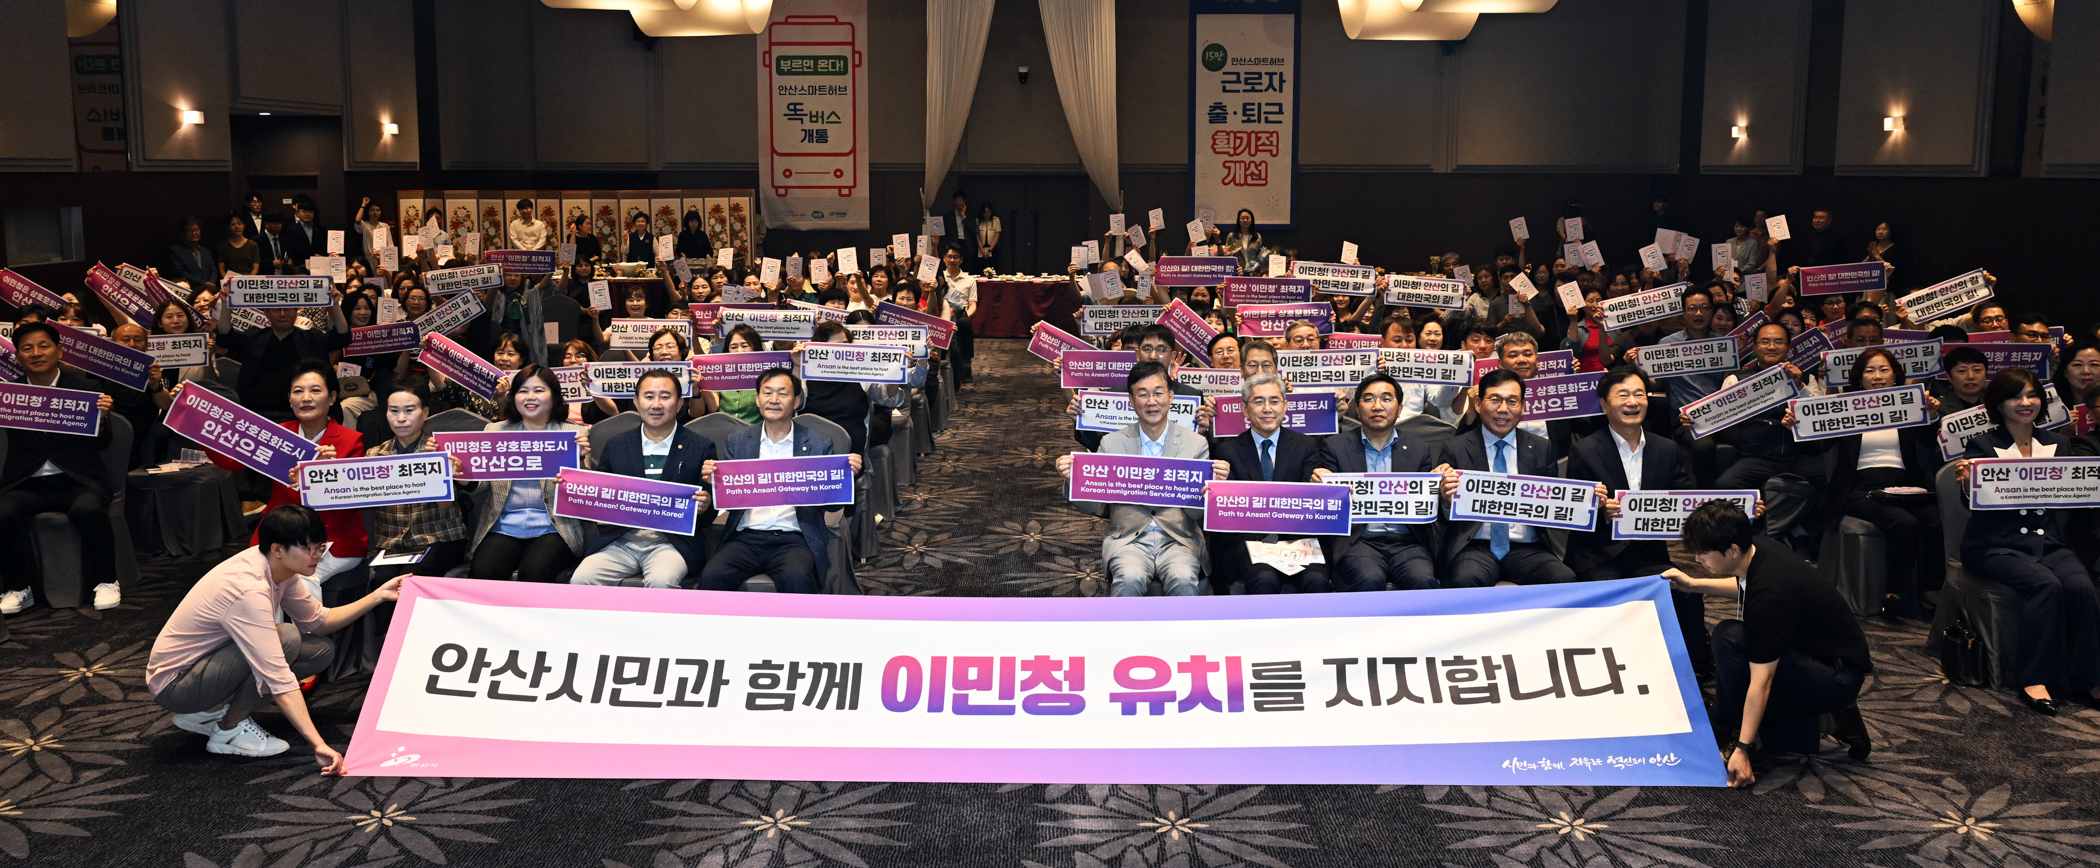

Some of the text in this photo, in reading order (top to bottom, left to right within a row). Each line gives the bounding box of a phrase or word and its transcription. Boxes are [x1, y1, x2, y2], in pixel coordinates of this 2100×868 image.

[1205, 51, 1225, 62] 15만
[1231, 58, 1285, 66] 안산스마트허브
[780, 60, 844, 72] 부르면 온다!
[1221, 72, 1286, 93] 근로자
[778, 86, 848, 96] 안산스마트허브
[800, 129, 829, 143] 개통
[1211, 130, 1279, 157] 획기적
[1222, 161, 1268, 186] 개선
[431, 271, 458, 281] 이민청!
[460, 268, 486, 277] 안산의
[237, 280, 323, 289] 이민청! 안산의 길
[438, 277, 492, 291] 대한민국의 길!
[1394, 279, 1459, 293] 이민청! 안산의 길
[1907, 275, 1978, 308] 이민청! 안산의 길
[244, 293, 317, 303] 대한민국의 길!
[1397, 292, 1454, 304] 대한민국의 길!
[1609, 288, 1683, 312] 이민청! 안산의 길
[1915, 291, 1979, 318] 대한민국의 길!
[725, 312, 744, 322] 안산
[782, 313, 812, 323] 최적지
[1617, 301, 1681, 323] 대한민국의 길!
[808, 349, 901, 363] 안산 ‘이민청’ 최적지
[1644, 342, 1727, 360] 이민청! 안산의 길
[1280, 354, 1371, 367] 이민청! 안산의 길
[1652, 357, 1723, 373] 대한민국의 길!
[1286, 370, 1364, 383] 대한민국의 길!
[1690, 404, 1711, 420] 안산
[1752, 372, 1784, 392] 최적지
[1802, 391, 1914, 416] 이민청! 안산의 길
[50, 398, 89, 412] 최적지
[186, 395, 306, 460] 이민청은 상호문화도시
[1812, 410, 1908, 432] 대한민국의 길!
[201, 420, 274, 465] 안산으로
[444, 441, 567, 453] 이민청은 상호문화도시
[470, 456, 543, 472] 안산으로
[308, 462, 442, 483] 안산 ‘이민청’ 최적지
[723, 469, 844, 485] 안산의 길! 대한민국의 길!
[1082, 465, 1202, 483] 안산 ‘이민청’ 최적지
[1981, 468, 2010, 482] 안산
[2015, 467, 2067, 481] ‘이민청’
[566, 483, 689, 509] 안산의 길! 대한민국의 길!
[778, 485, 809, 493] Gateway
[1466, 479, 1586, 502] 이민청! 안산의 길
[594, 501, 618, 509] Ansan!
[620, 505, 651, 515] Gateway
[662, 510, 684, 518] Korea!
[1216, 496, 1342, 510] 안산의 길! 대한민국의 길!
[1472, 500, 1574, 521] 대한민국의 길!
[1272, 512, 1304, 520] Gateway
[425, 642, 1651, 716] 안산시민과 함께 이민청 유치를 지지합니다.
[1502, 757, 1538, 774] 시민과
[1649, 753, 1681, 766] 안산
